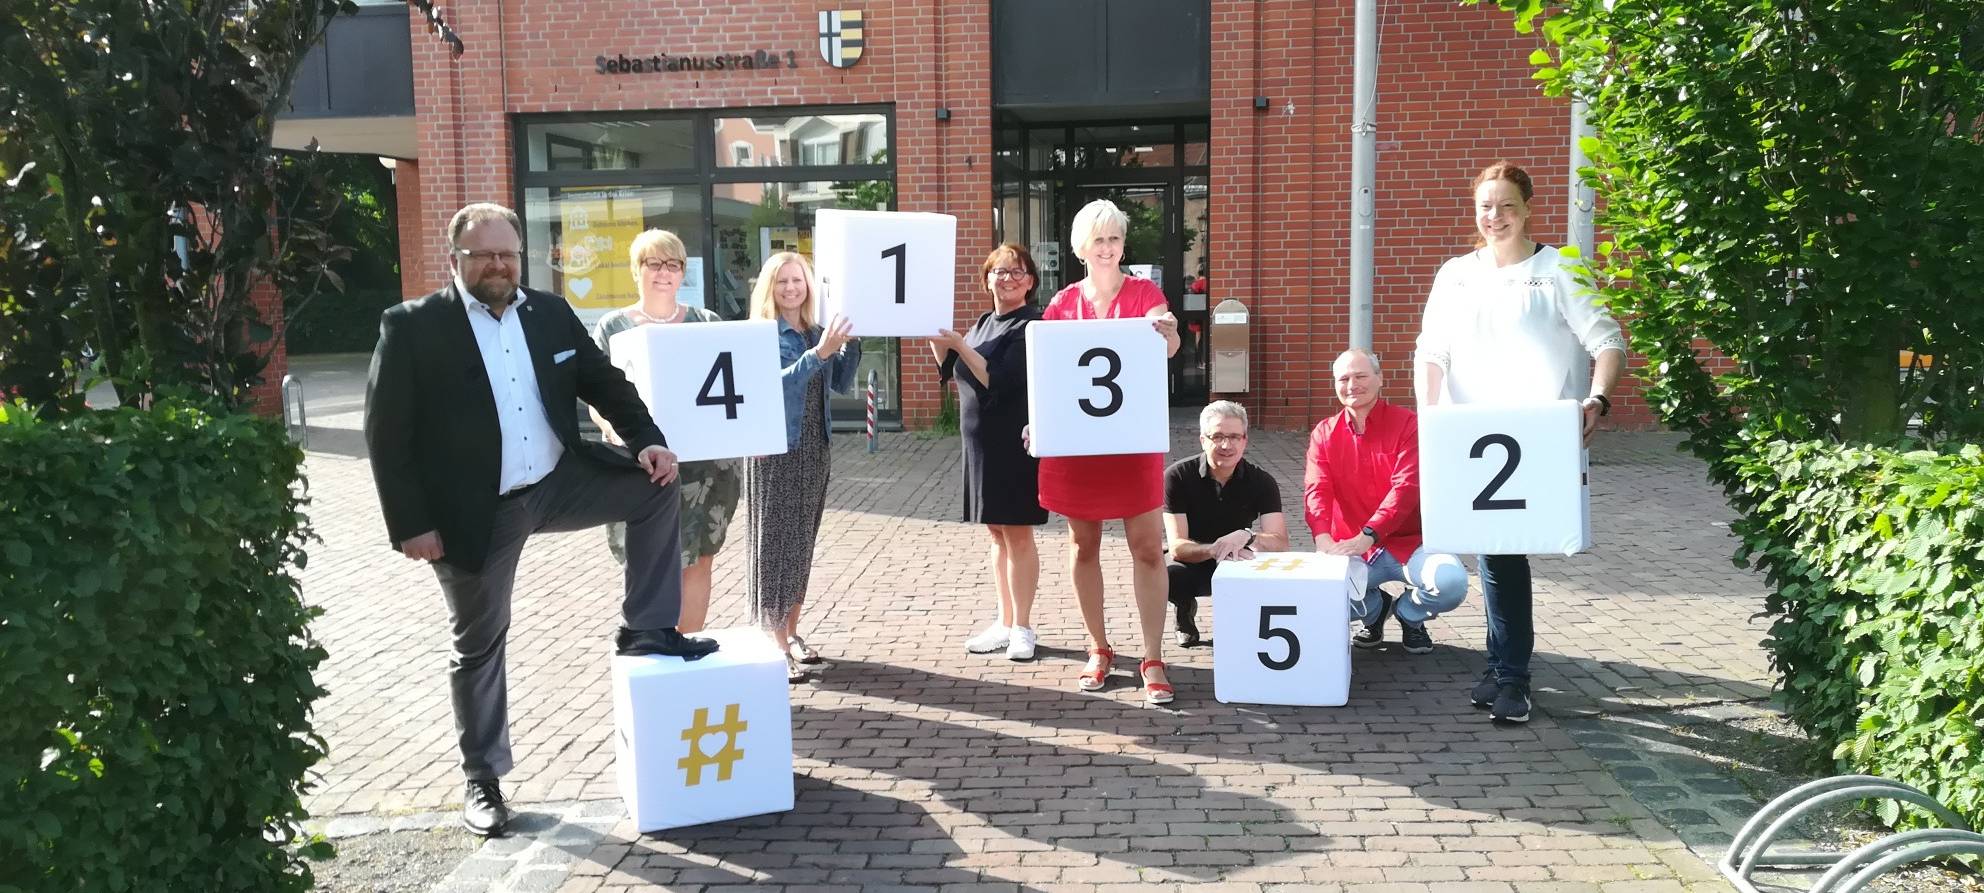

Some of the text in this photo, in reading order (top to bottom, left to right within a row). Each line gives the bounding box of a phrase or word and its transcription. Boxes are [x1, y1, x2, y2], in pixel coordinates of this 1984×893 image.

[595, 49, 798, 75] Sebastianusstraße 1
[881, 243, 906, 304] 1
[695, 351, 745, 420] 4
[1077, 347, 1124, 418] 3
[1469, 433, 1527, 511] 2
[1257, 605, 1301, 671] 5
